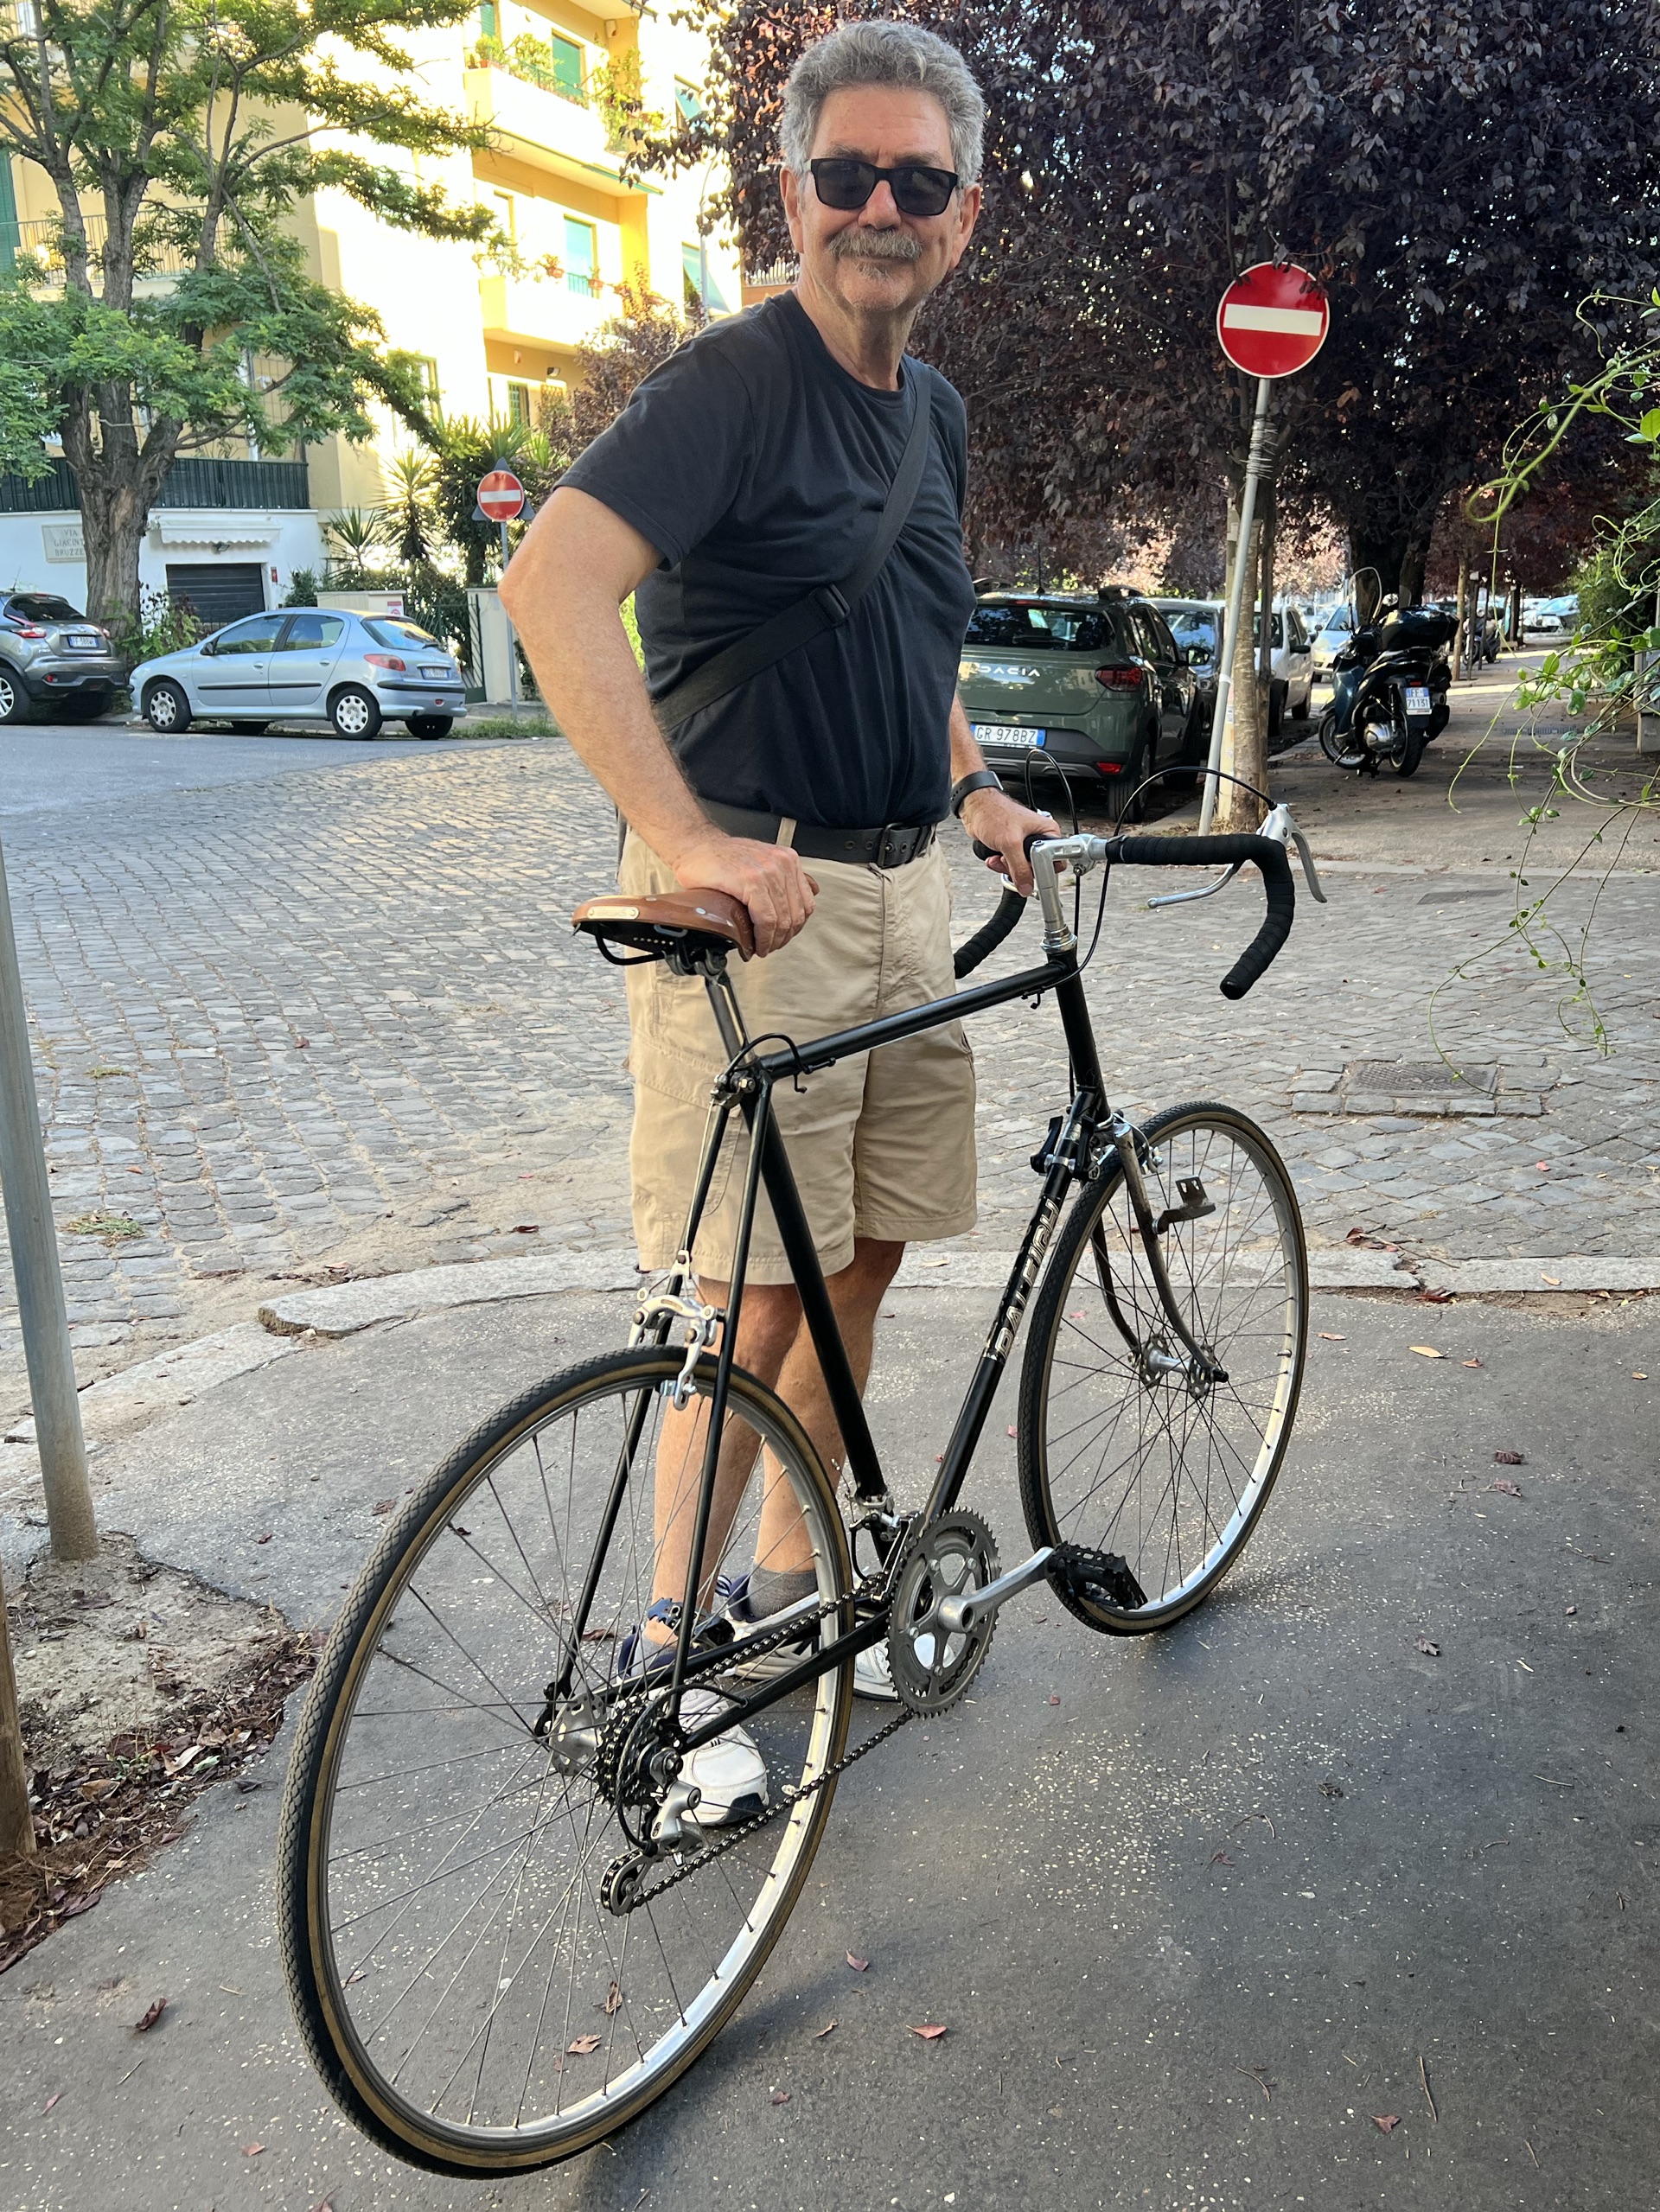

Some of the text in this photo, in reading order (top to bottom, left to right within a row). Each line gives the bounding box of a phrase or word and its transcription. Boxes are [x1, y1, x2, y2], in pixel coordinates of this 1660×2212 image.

[980, 665, 1041, 677] DACIA
[1408, 698, 1428, 708] 71131
[976, 727, 1037, 743] GR 978BZ
